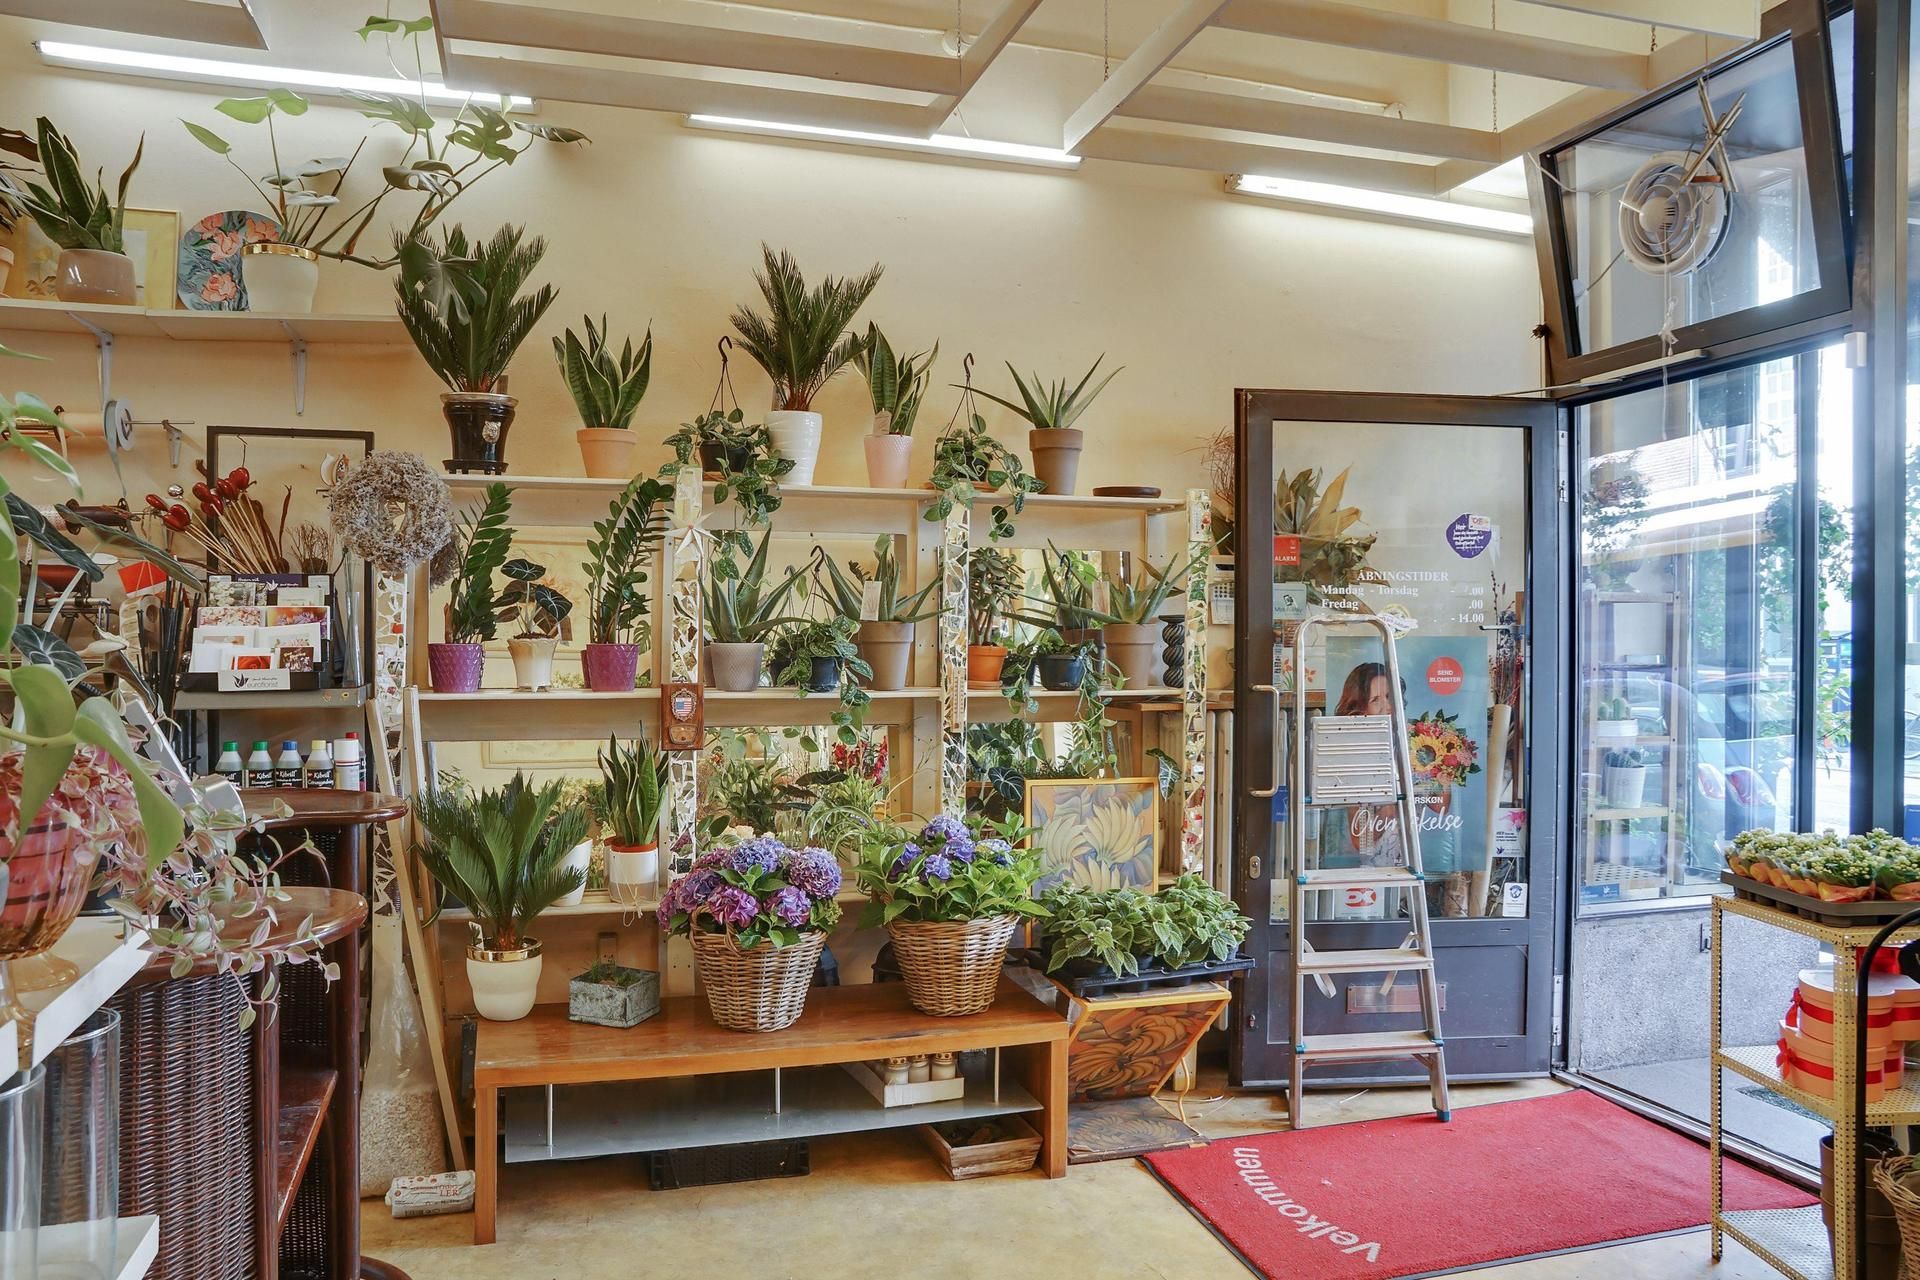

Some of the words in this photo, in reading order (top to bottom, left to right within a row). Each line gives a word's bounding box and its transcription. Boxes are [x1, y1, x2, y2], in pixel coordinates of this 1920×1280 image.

[1357, 569, 1449, 582] ÅBNINGSTIDER
[1321, 584, 1365, 597] Mandag
[1376, 585, 1419, 598] Torsdag
[1321, 599, 1360, 611] Fredag
[1413, 796, 1444, 804] RSKØN
[1232, 1147, 1382, 1263] Velkommen
